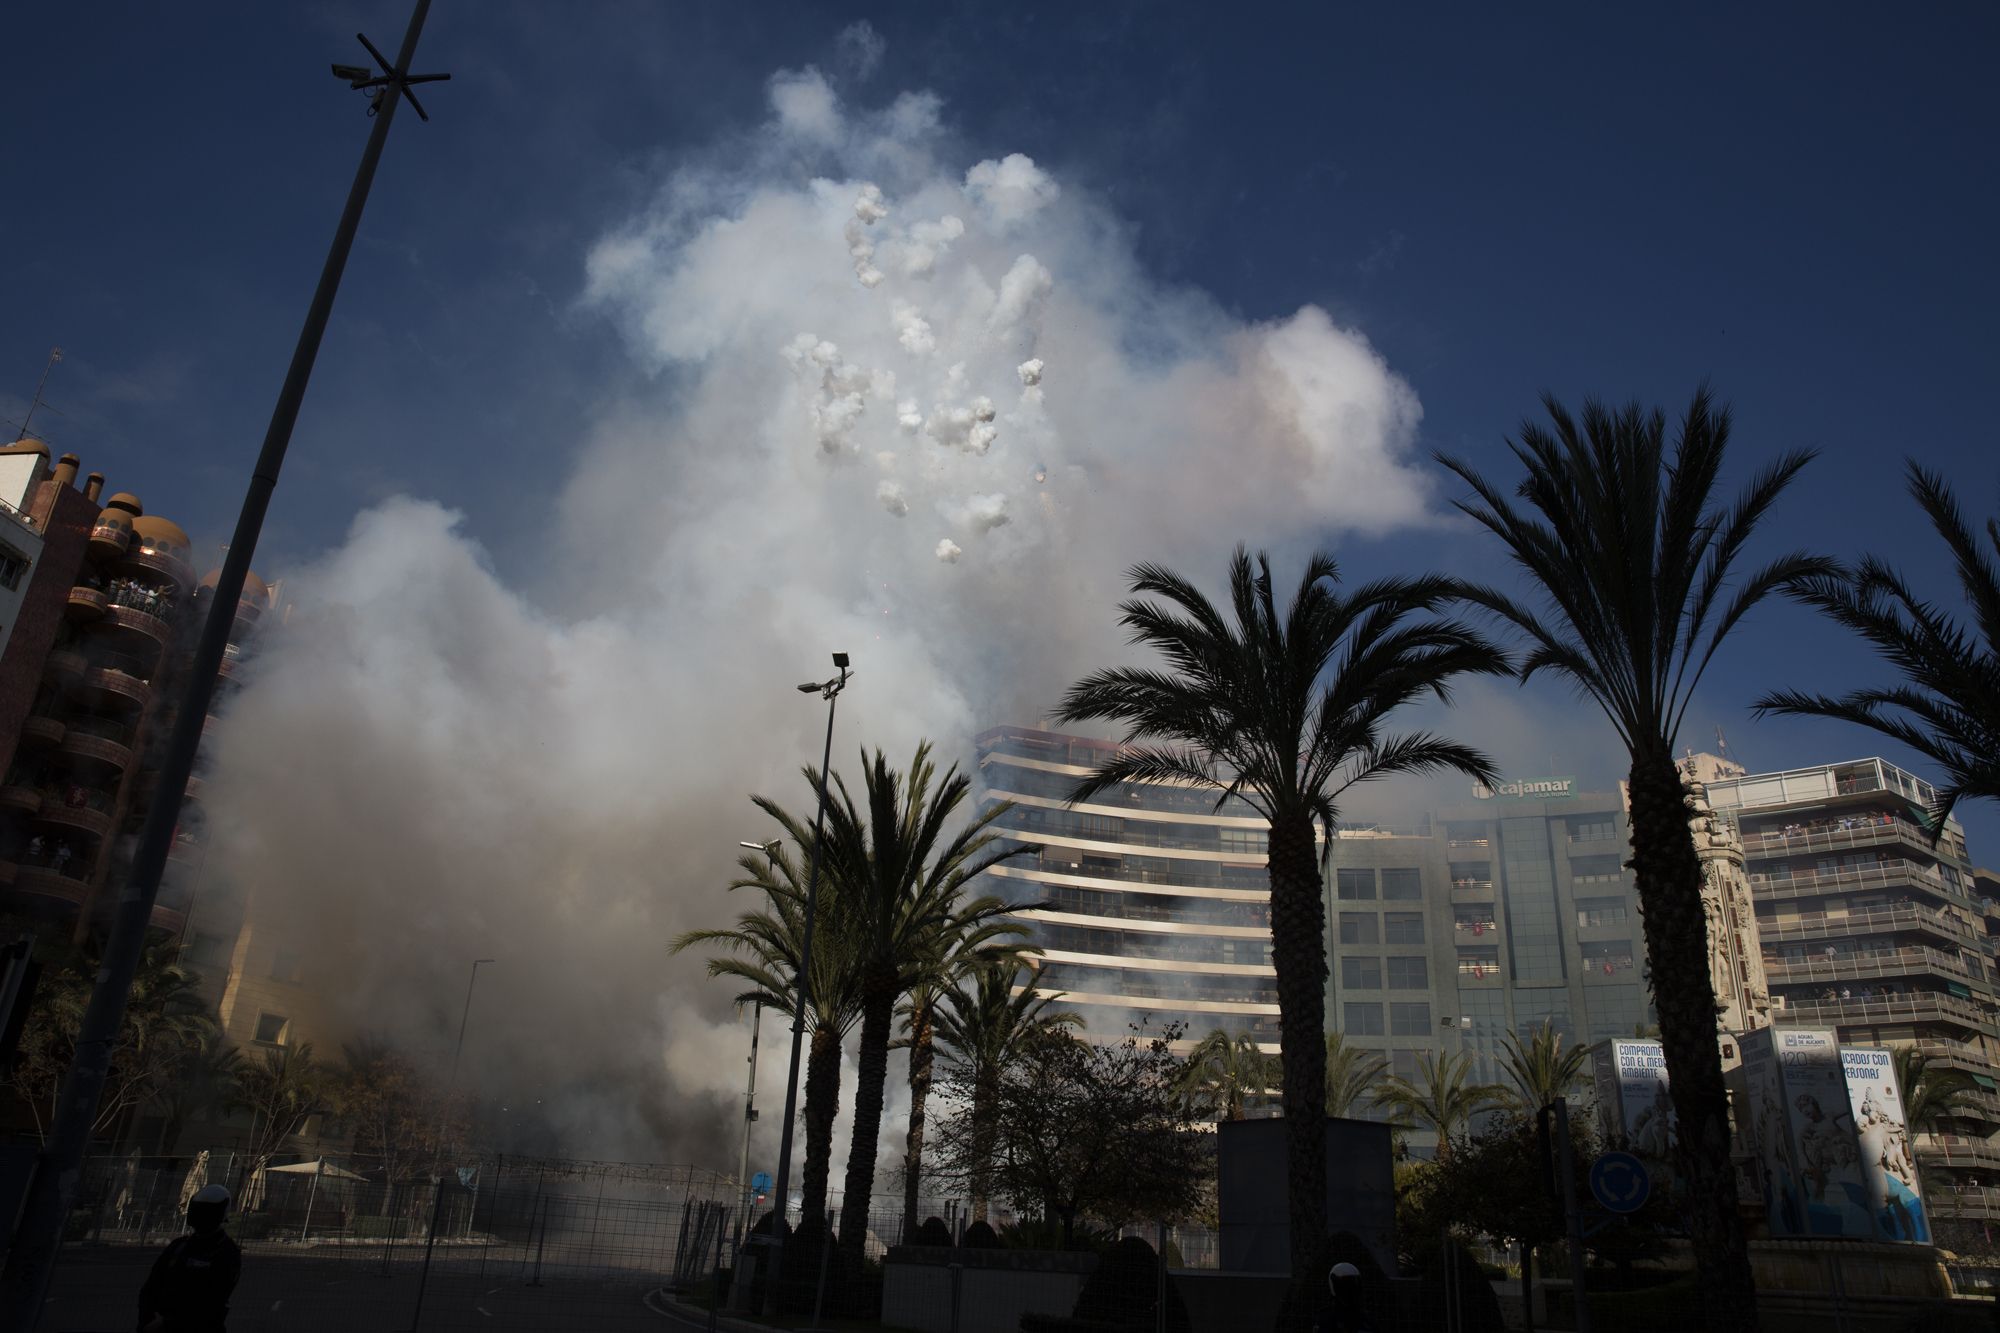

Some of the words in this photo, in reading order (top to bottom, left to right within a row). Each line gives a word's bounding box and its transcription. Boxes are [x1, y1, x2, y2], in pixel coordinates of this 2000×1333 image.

[1498, 779, 1571, 798] cajamar
[1620, 1045, 1663, 1056] COMPROME
[1621, 1056, 1635, 1066] CON
[1637, 1057, 1645, 1067] EL
[1782, 1051, 1808, 1066] 120
[1843, 1053, 1870, 1065] ICADOS
[1872, 1054, 1889, 1065] CON
[1622, 1068, 1658, 1078] AMBIENTE
[1845, 1067, 1880, 1079] ERSONAS
